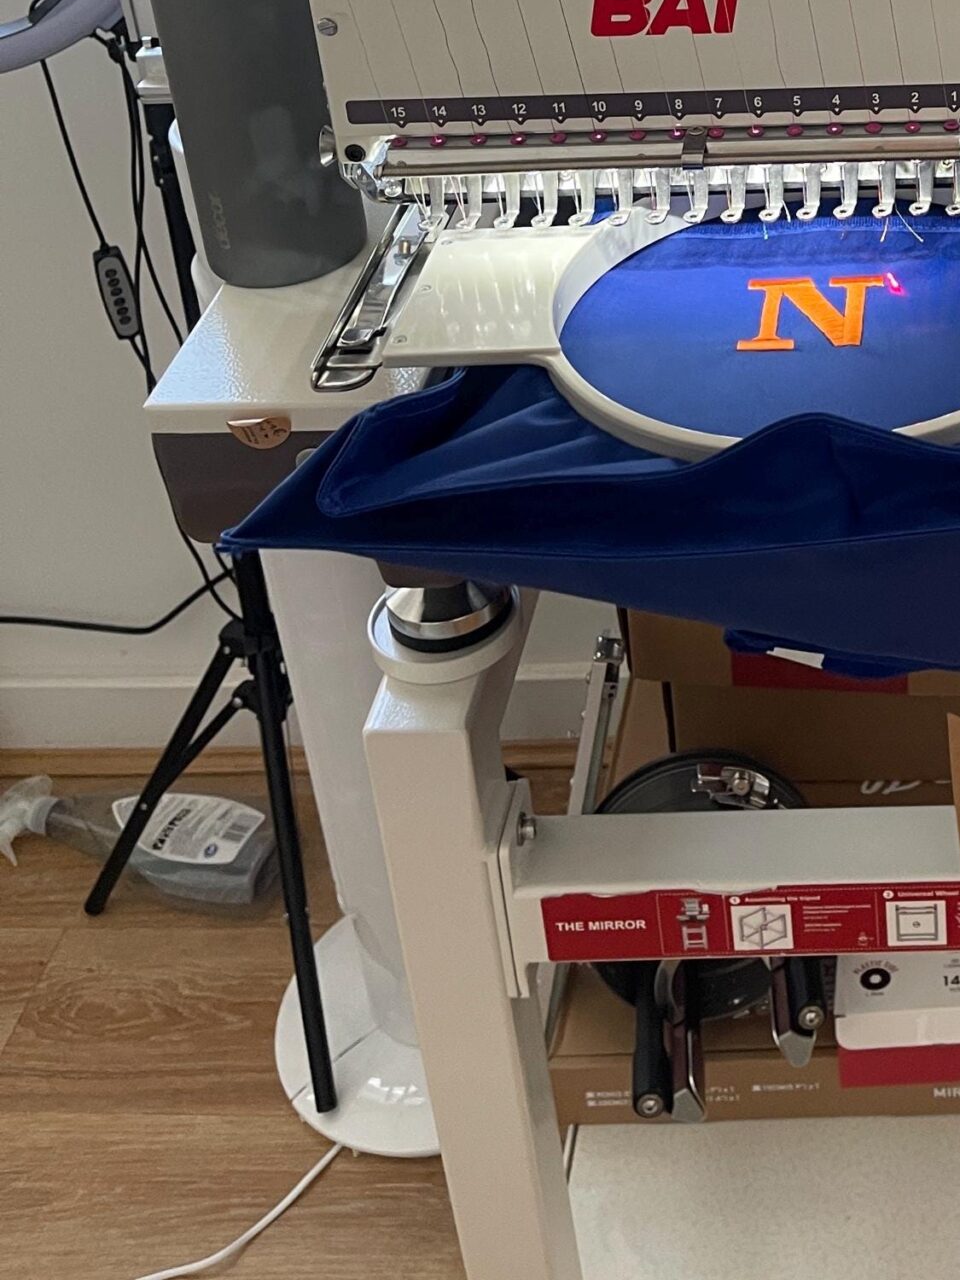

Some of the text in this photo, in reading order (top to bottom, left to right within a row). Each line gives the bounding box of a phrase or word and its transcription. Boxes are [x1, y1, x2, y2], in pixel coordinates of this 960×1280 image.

[390, 91, 957, 118] 15 14 13 12 11 10 9 8 7 6 5 4 3 2 1
[736, 275, 884, 351] N
[555, 920, 646, 931] THE MIRROR
